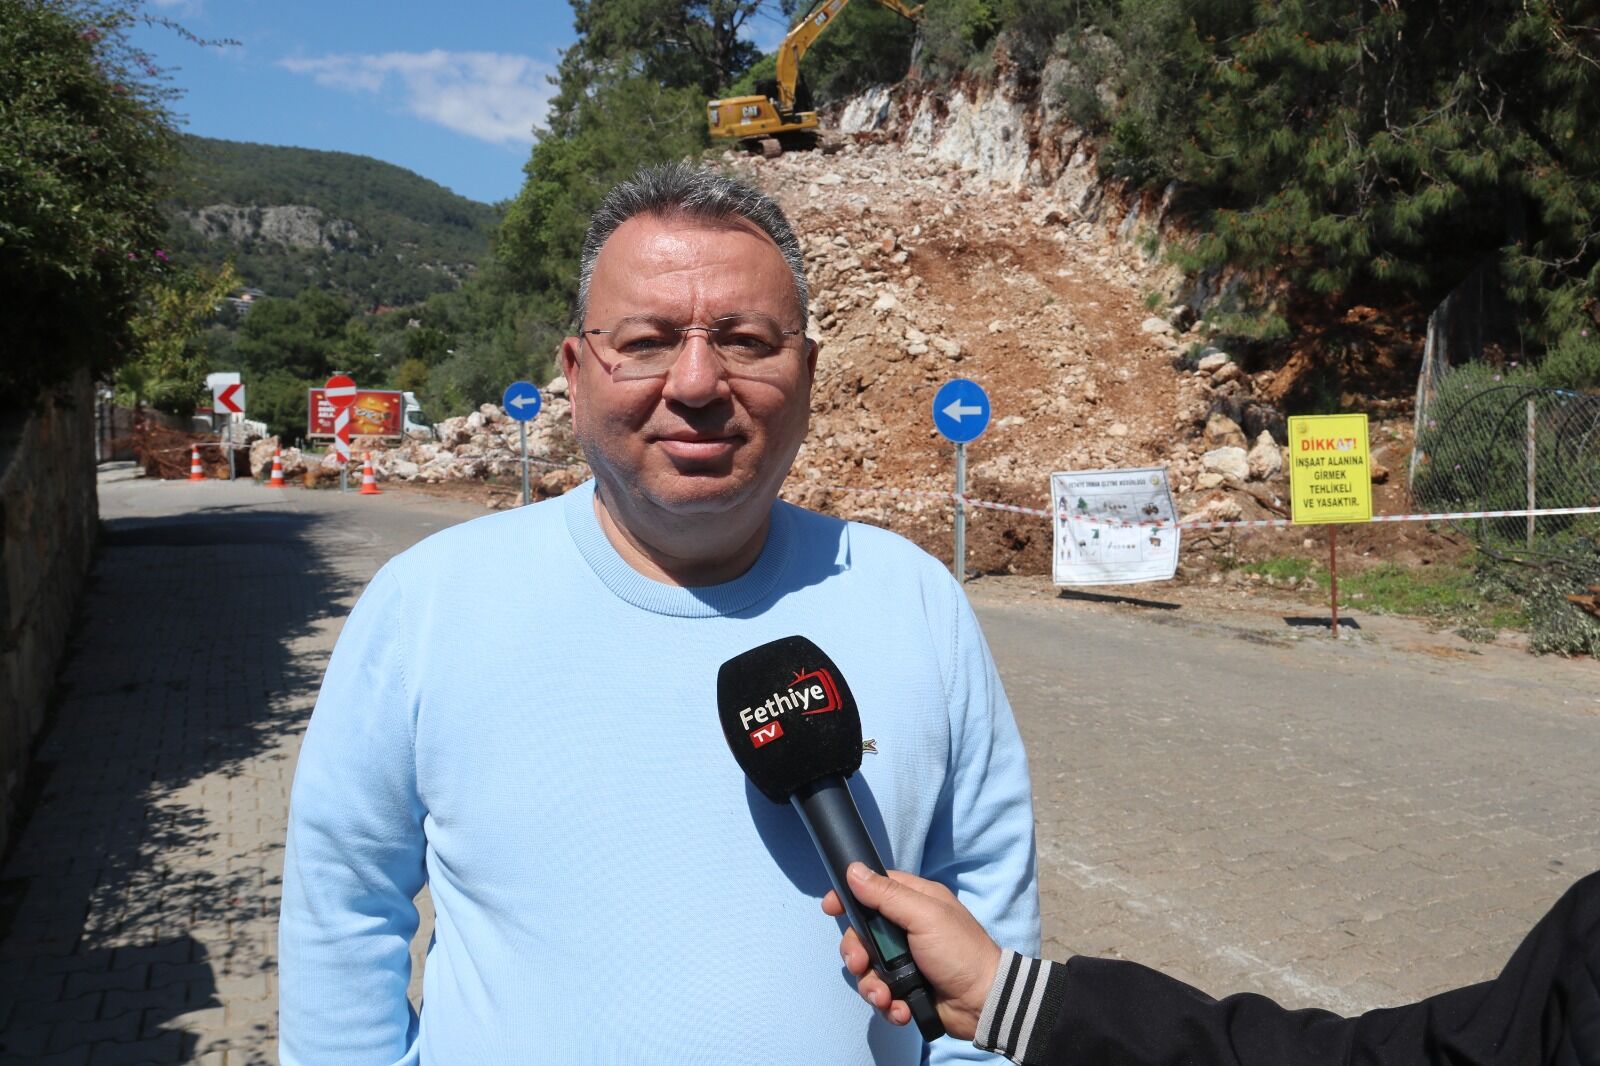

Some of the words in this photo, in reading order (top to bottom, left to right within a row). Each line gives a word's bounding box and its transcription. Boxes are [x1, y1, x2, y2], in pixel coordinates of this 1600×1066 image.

[742, 105, 758, 116] CAT
[1296, 457, 1326, 469] İNŞAAT
[1328, 456, 1363, 466] ALANINA
[1314, 469, 1346, 480] GİRMEK
[1309, 482, 1352, 494] TEHLİKELİ
[1303, 499, 1314, 508] VE
[739, 684, 825, 731] Fethiye
[753, 724, 777, 742] TV
